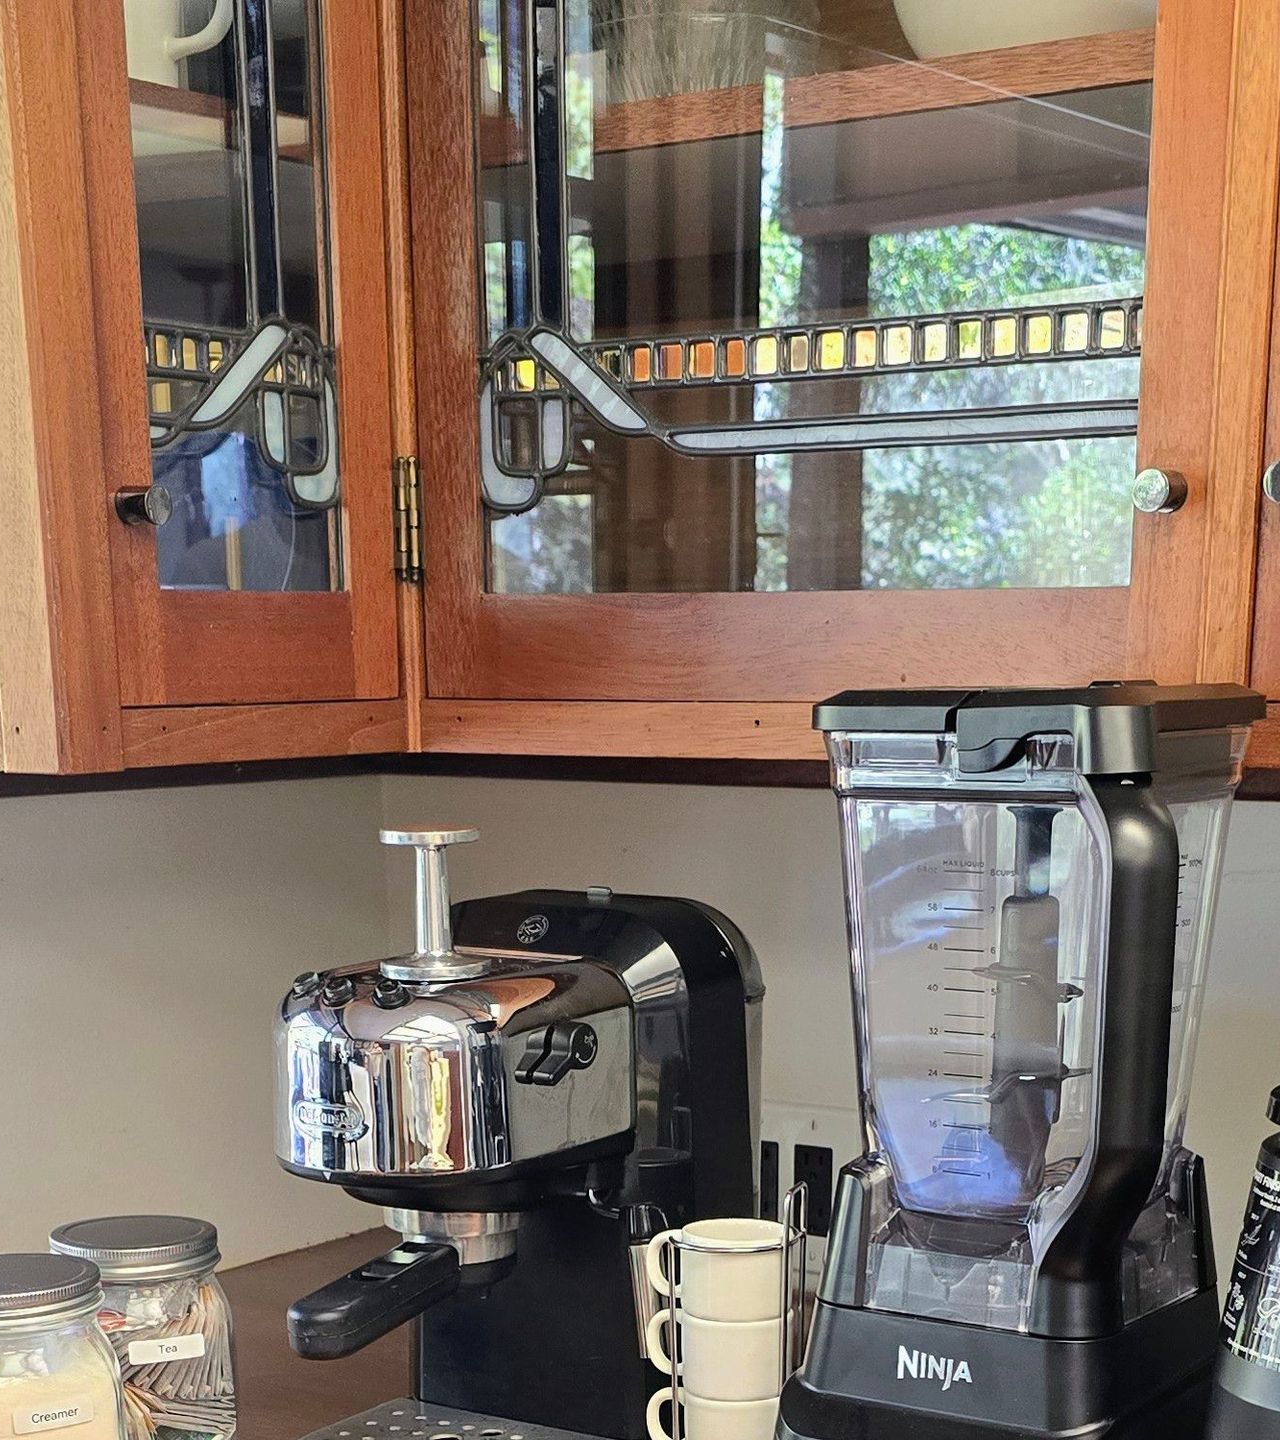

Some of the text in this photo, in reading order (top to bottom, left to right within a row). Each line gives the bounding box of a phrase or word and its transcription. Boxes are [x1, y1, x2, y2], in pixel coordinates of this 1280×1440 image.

[927, 943, 996, 954] 48 6
[927, 984, 939, 992] 40
[928, 1027, 939, 1036] 32
[157, 1343, 178, 1355] Tea
[896, 1344, 973, 1392] NINJA
[31, 1405, 79, 1424] Creamer
